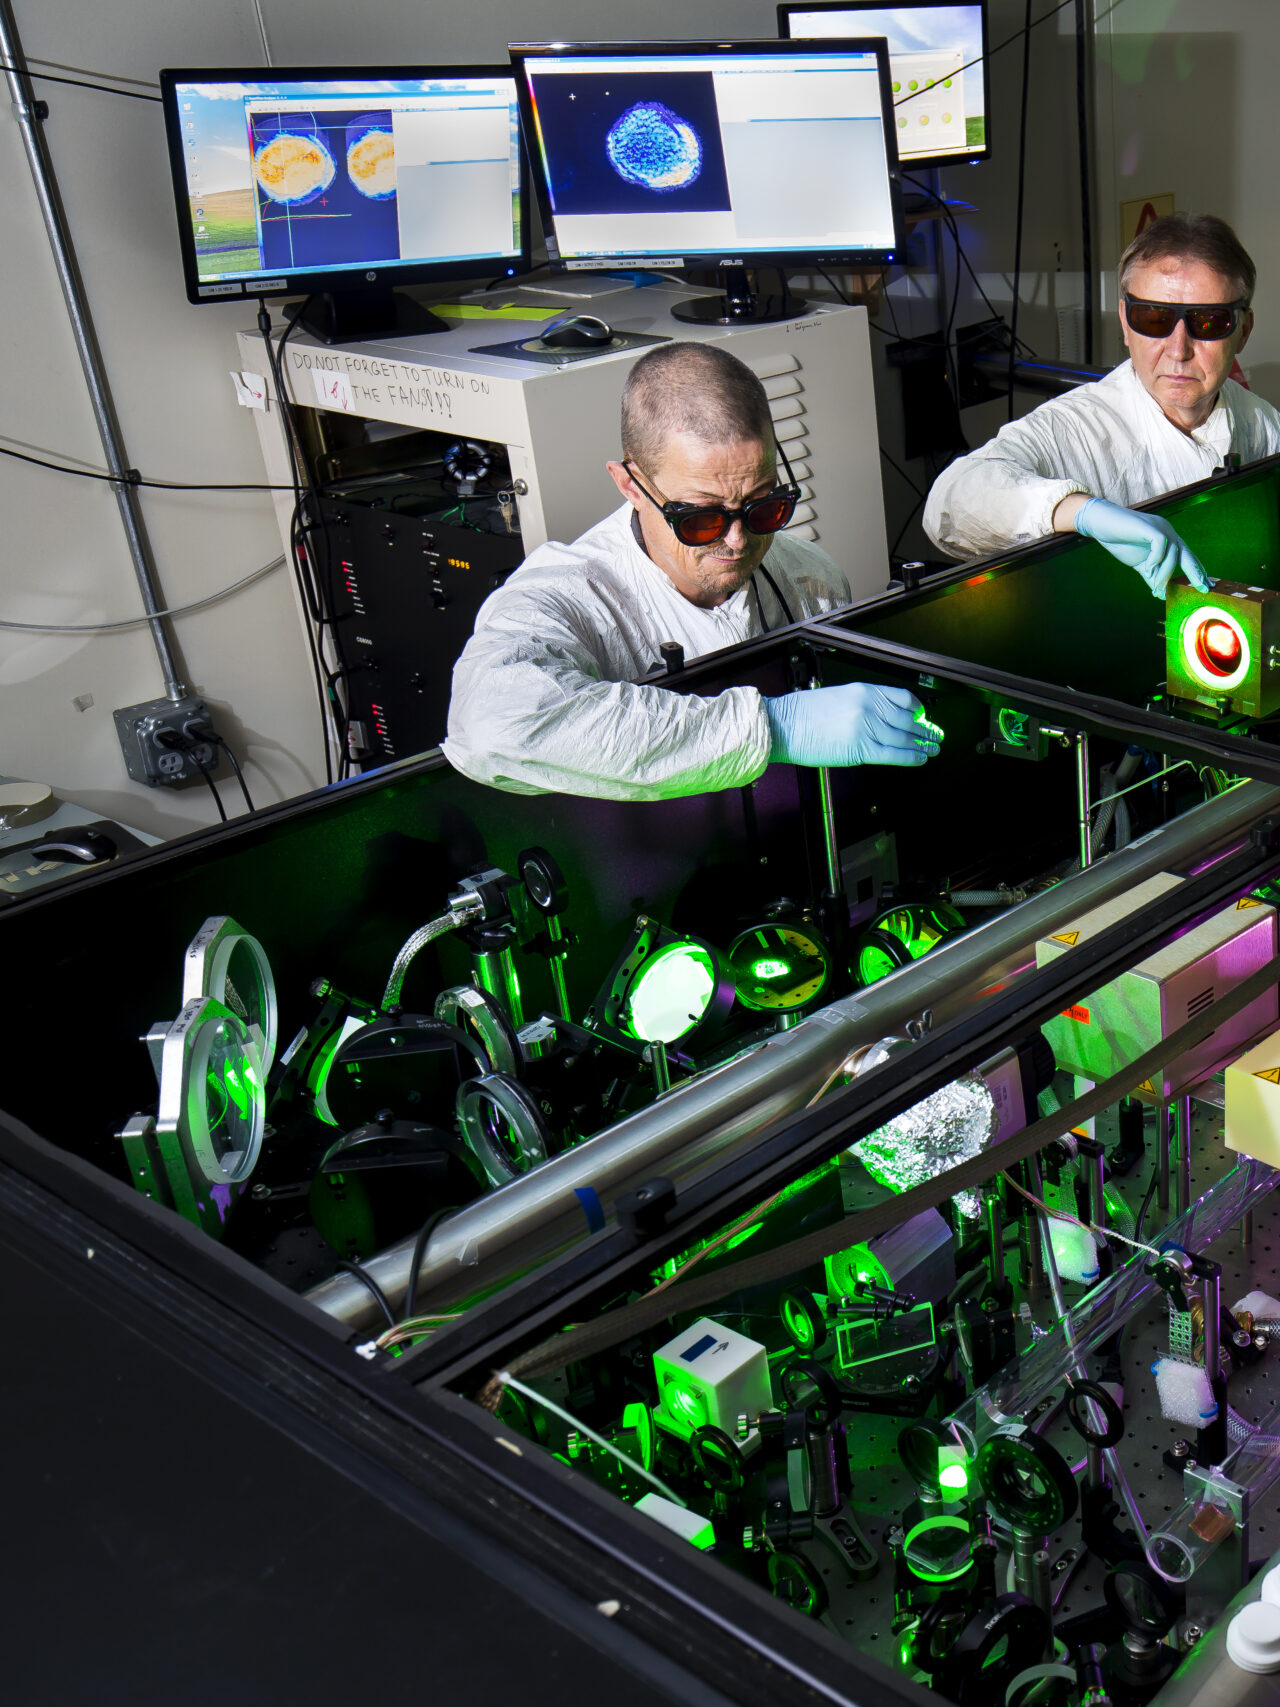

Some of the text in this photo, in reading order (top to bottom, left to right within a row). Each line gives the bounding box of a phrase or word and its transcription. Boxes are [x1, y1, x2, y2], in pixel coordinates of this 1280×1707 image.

[719, 259, 744, 267] ASUS
[293, 352, 491, 395] DO NOT FORGET TO TURN ON
[352, 385, 380, 403] THE
